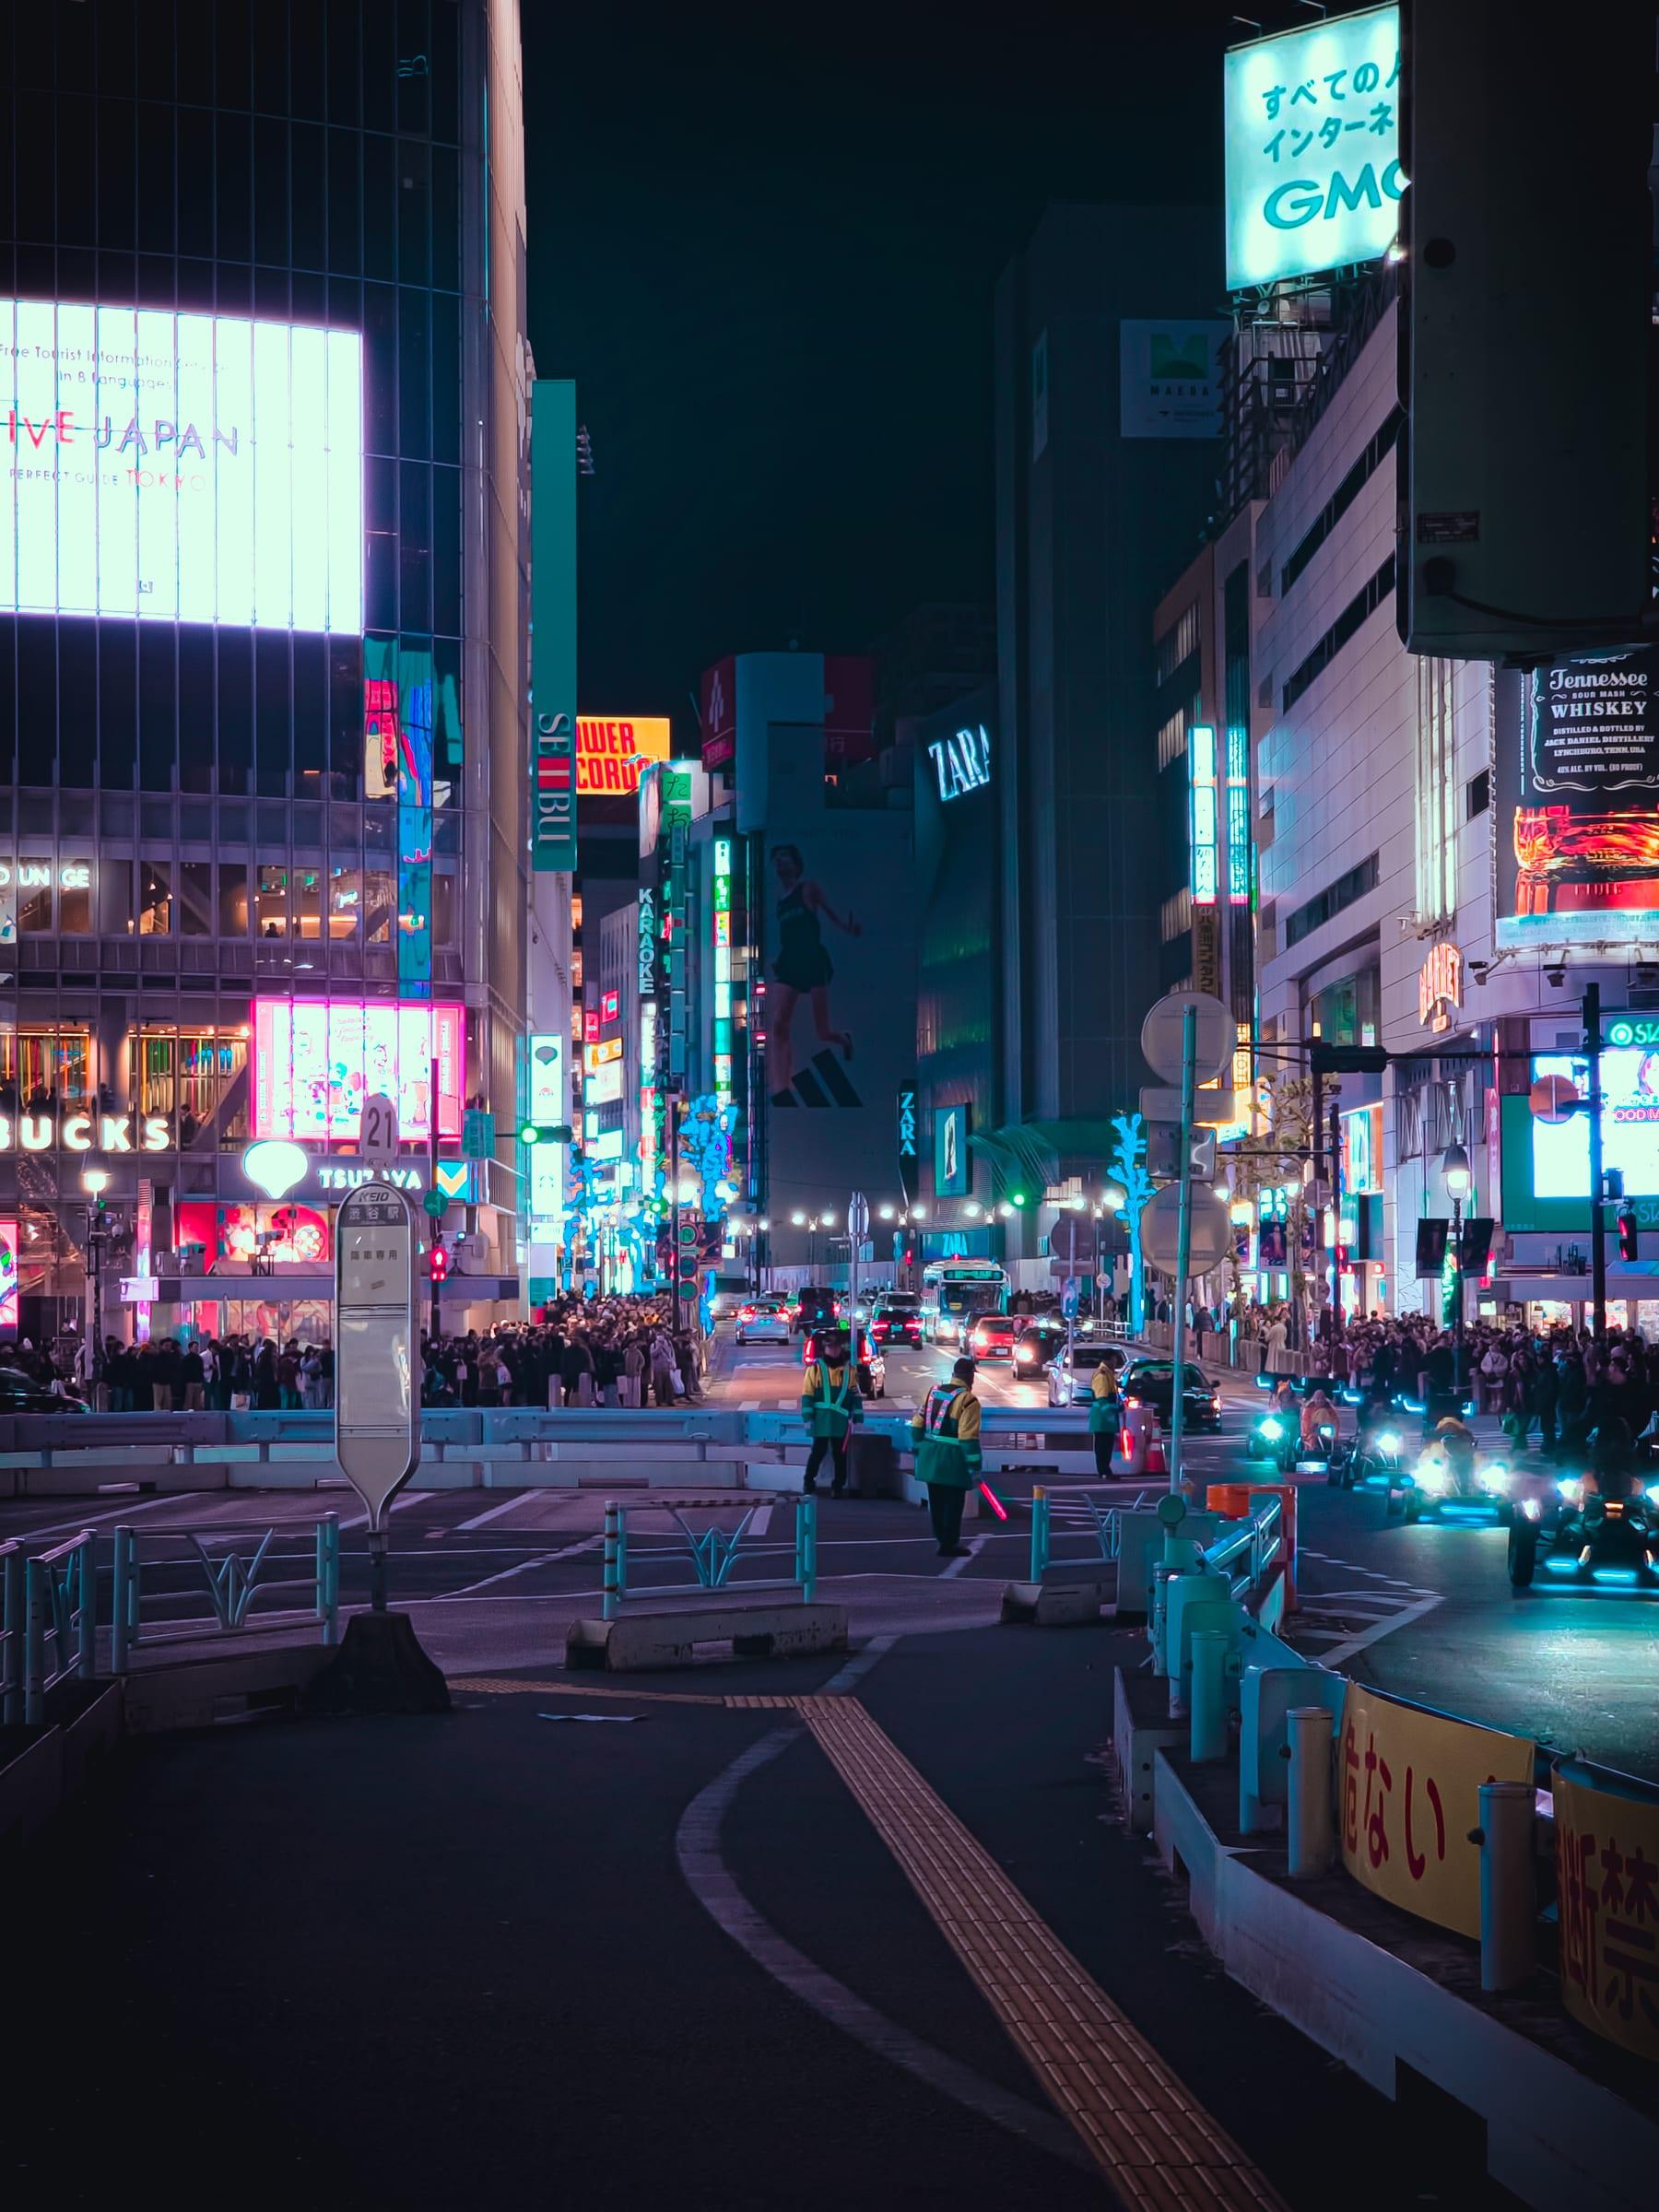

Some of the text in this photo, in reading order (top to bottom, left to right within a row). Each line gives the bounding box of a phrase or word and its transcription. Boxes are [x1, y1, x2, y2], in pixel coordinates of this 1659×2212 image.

[35, 347, 81, 361] Tourist
[1150, 384, 1209, 396] MAEDA
[9, 410, 237, 459] IVE JAPAN
[75, 471, 118, 486] GUDE
[1549, 669, 1648, 690] Tennessee
[1572, 690, 1625, 700] SOUR MASH
[1551, 701, 1648, 719] WHISKEY
[576, 722, 636, 754] WER
[1553, 727, 1591, 735] DISTILLED
[1545, 735, 1654, 747] JACK DANIEL DISTILLERY
[537, 712, 571, 841] SEIBU
[639, 888, 654, 994] KARAOKE
[368, 1107, 392, 1148] 21
[900, 1092, 916, 1156] ZARA
[319, 1169, 421, 1189] TSUTYA
[359, 1193, 389, 1202] KEIO
[349, 1206, 399, 1220] 渋谷駅
[1557, 1829, 1659, 2026] 断禁
